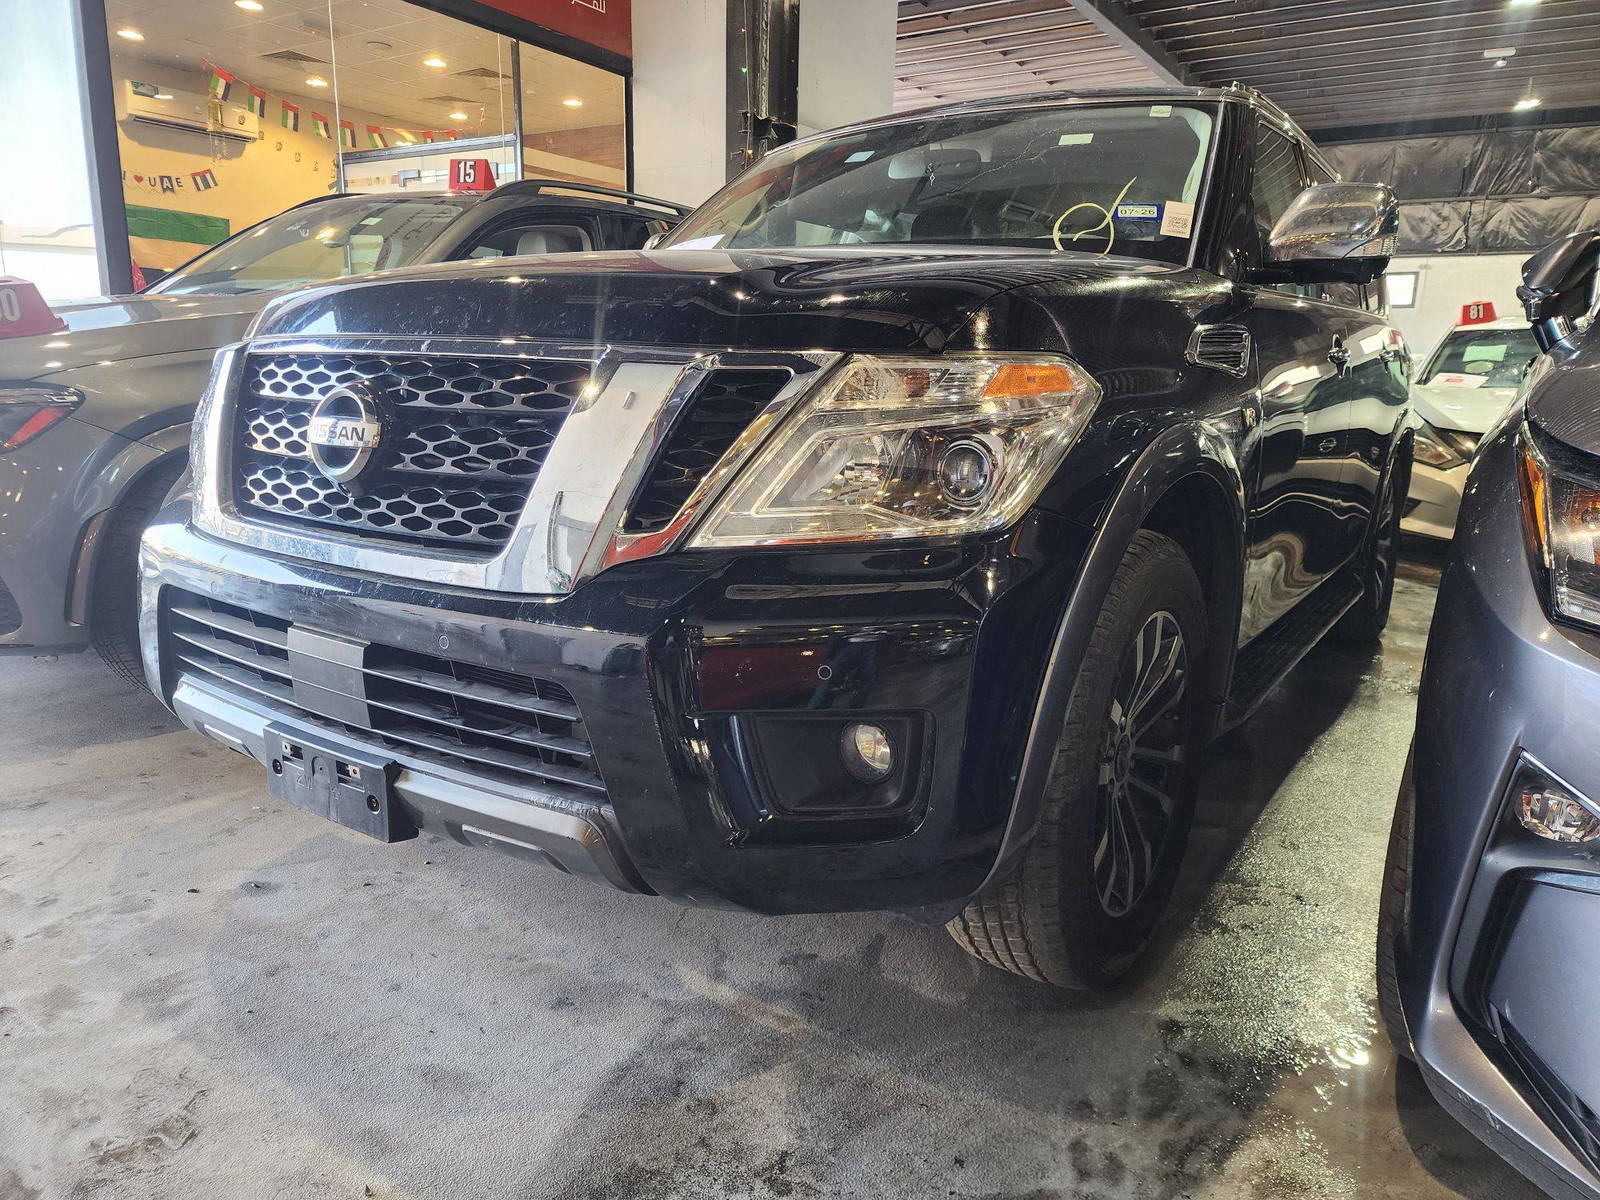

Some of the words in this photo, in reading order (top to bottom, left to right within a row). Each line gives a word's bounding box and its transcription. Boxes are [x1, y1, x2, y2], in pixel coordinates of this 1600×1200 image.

[458, 161, 475, 183] 15
[148, 177, 184, 189] UAE
[1469, 303, 1484, 320] 81
[310, 423, 366, 442] ISSAN
